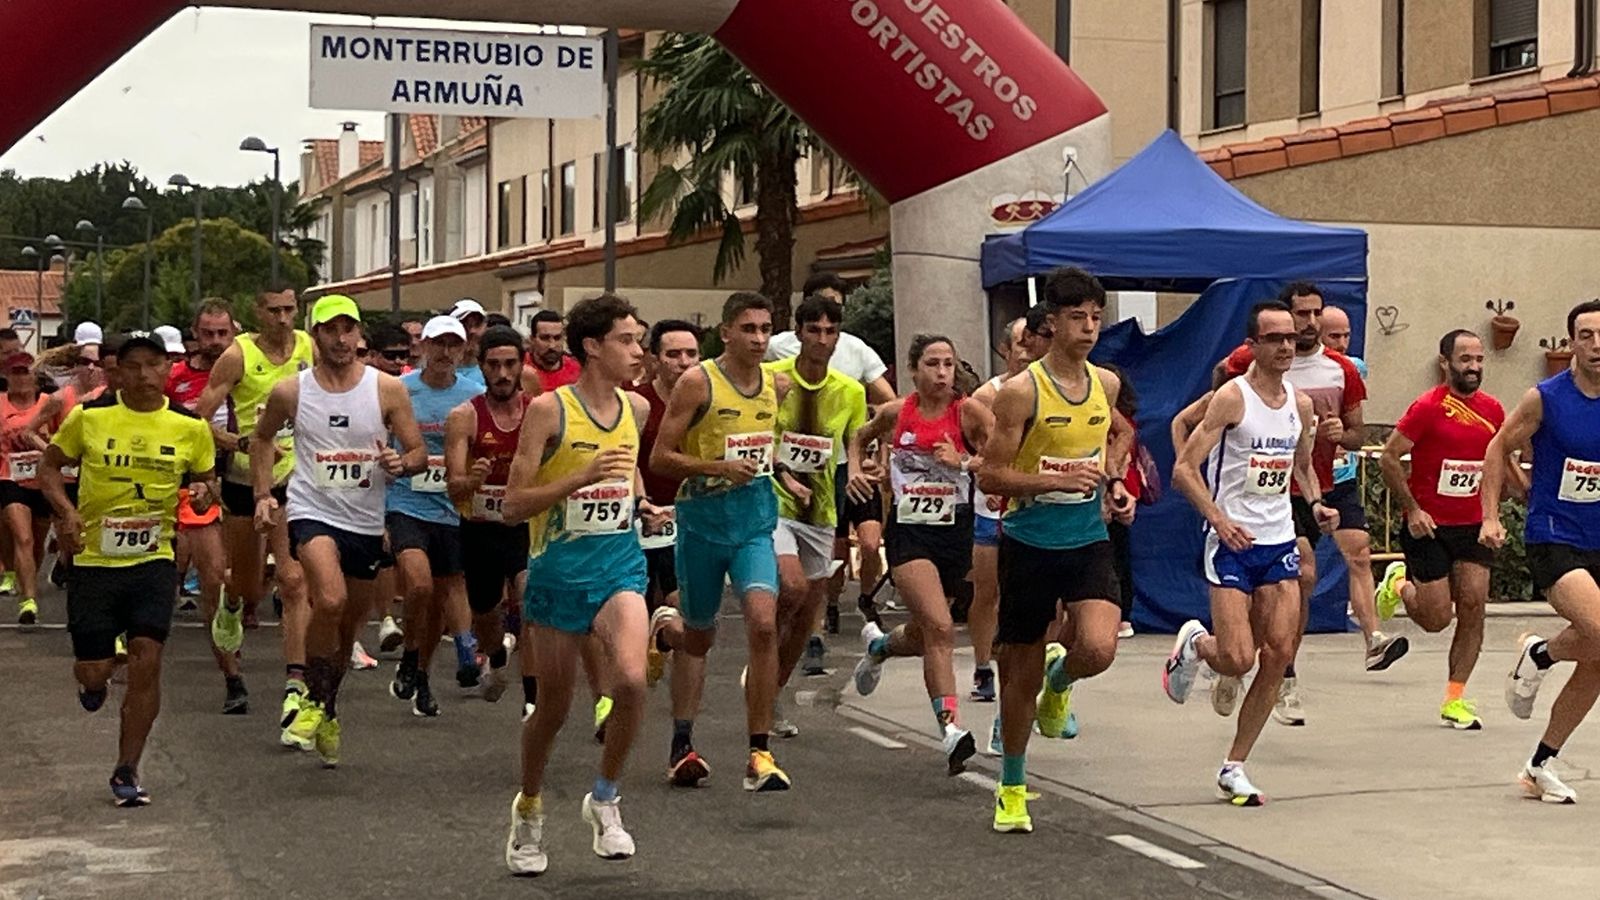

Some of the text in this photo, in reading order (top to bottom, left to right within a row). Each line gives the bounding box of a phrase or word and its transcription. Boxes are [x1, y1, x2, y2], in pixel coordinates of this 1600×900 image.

[321, 35, 594, 69] MONTERRUBIO DE
[391, 73, 524, 107] ARMUÑA
[790, 447, 822, 464] 793
[326, 464, 361, 480] 718
[1257, 471, 1286, 487] 838
[582, 502, 621, 522] 759
[910, 497, 944, 514] 729
[114, 530, 150, 547] 780
